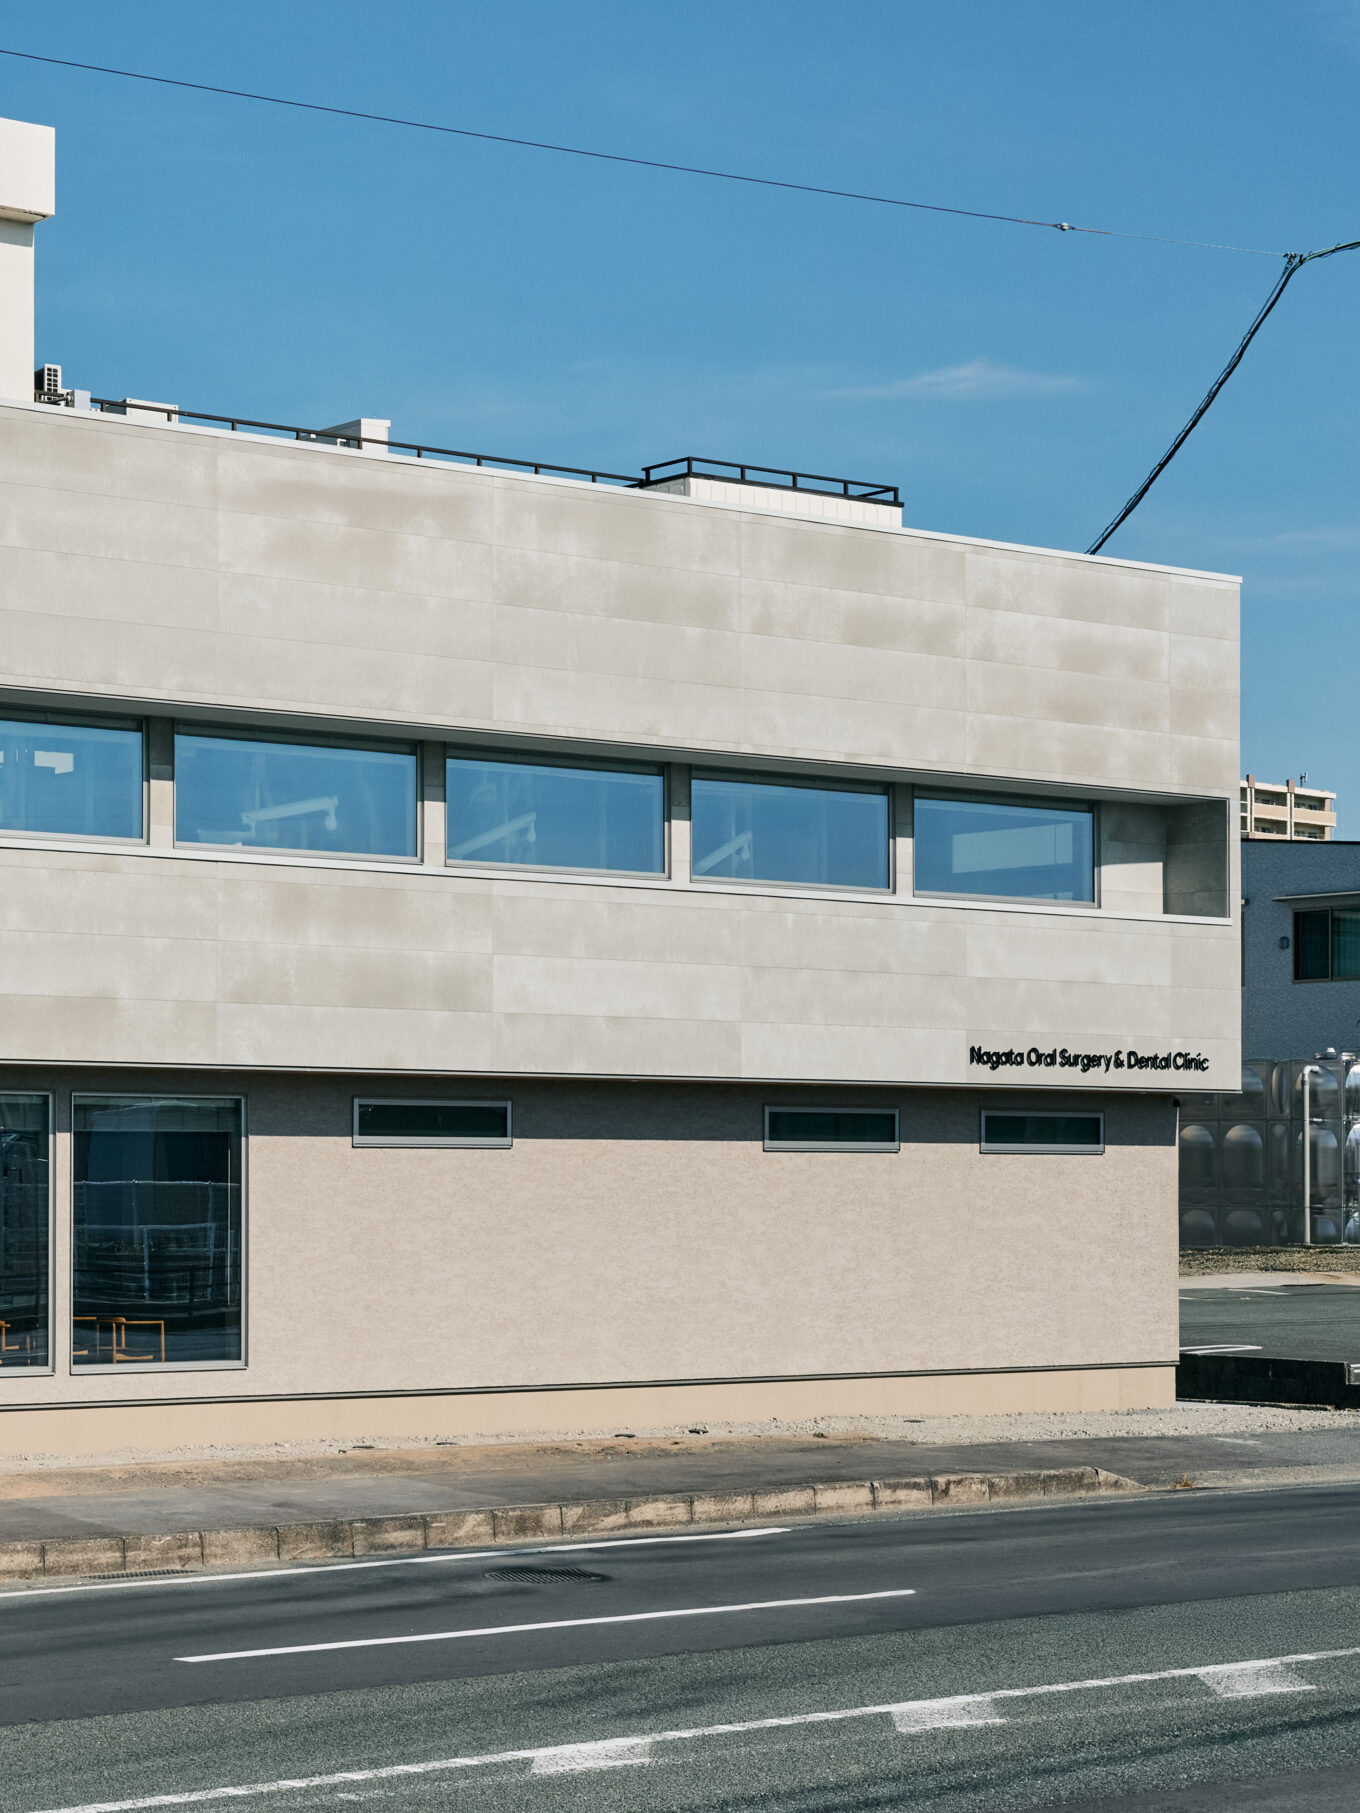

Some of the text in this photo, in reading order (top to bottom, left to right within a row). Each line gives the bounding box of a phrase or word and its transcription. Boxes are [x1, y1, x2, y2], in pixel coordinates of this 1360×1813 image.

[969, 1045, 1210, 1074] Nagata Oral Surgery & Dental Clinic
